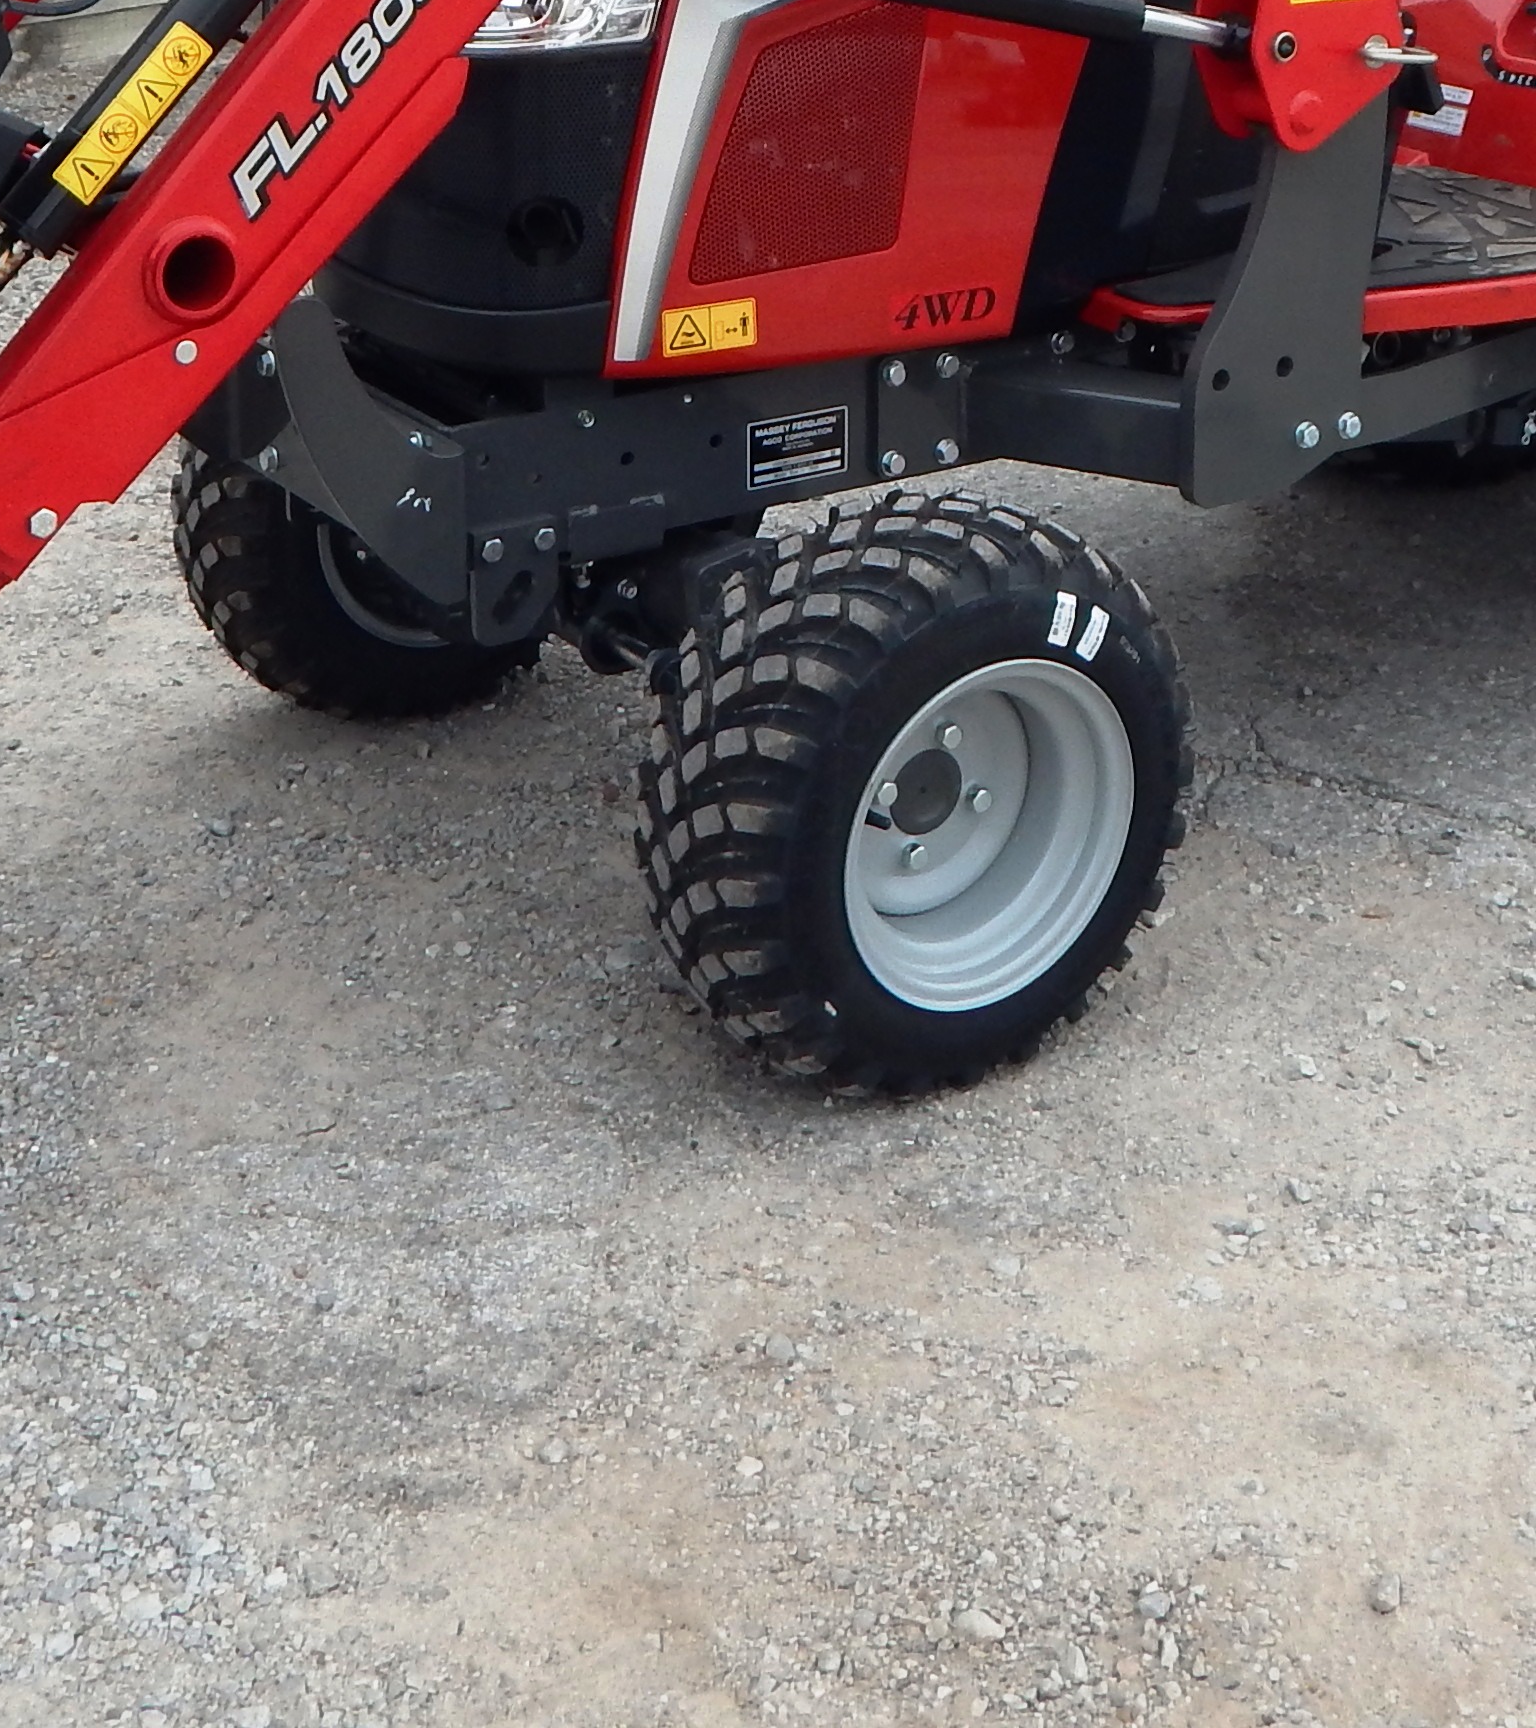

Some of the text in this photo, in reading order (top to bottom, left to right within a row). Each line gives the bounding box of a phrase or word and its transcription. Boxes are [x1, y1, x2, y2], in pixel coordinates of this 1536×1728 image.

[894, 286, 996, 331] 4WD
[755, 414, 837, 438] MASSEY FERGUSON
